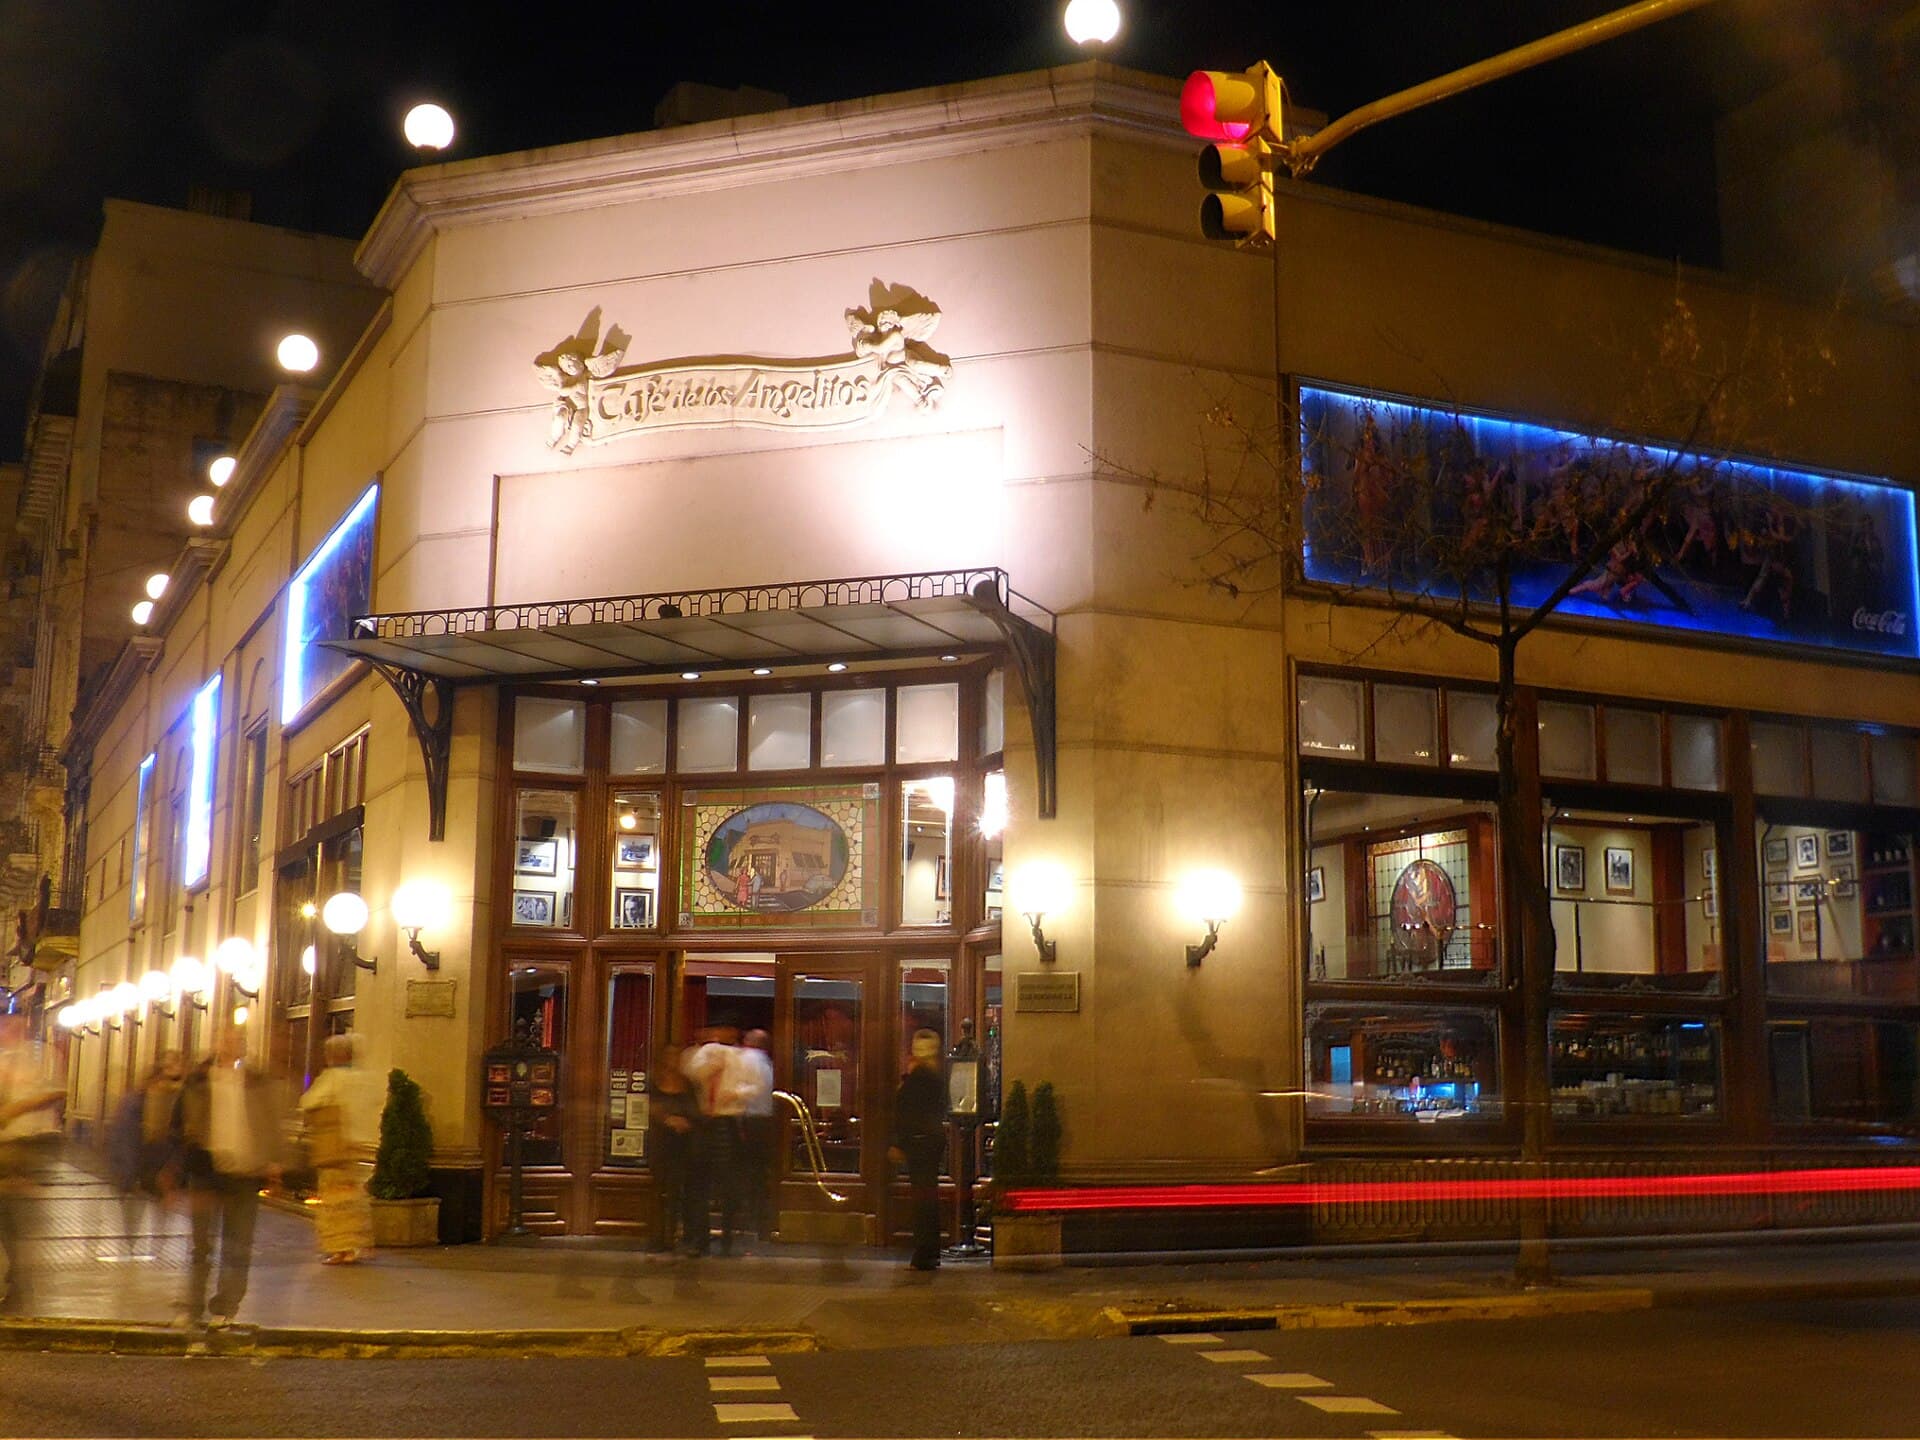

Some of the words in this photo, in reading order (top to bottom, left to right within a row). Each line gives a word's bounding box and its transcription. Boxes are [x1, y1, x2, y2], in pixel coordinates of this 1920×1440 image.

[598, 375, 669, 422] Café
[671, 379, 702, 408] de
[703, 378, 737, 406] los
[737, 369, 870, 418] Angelitos
